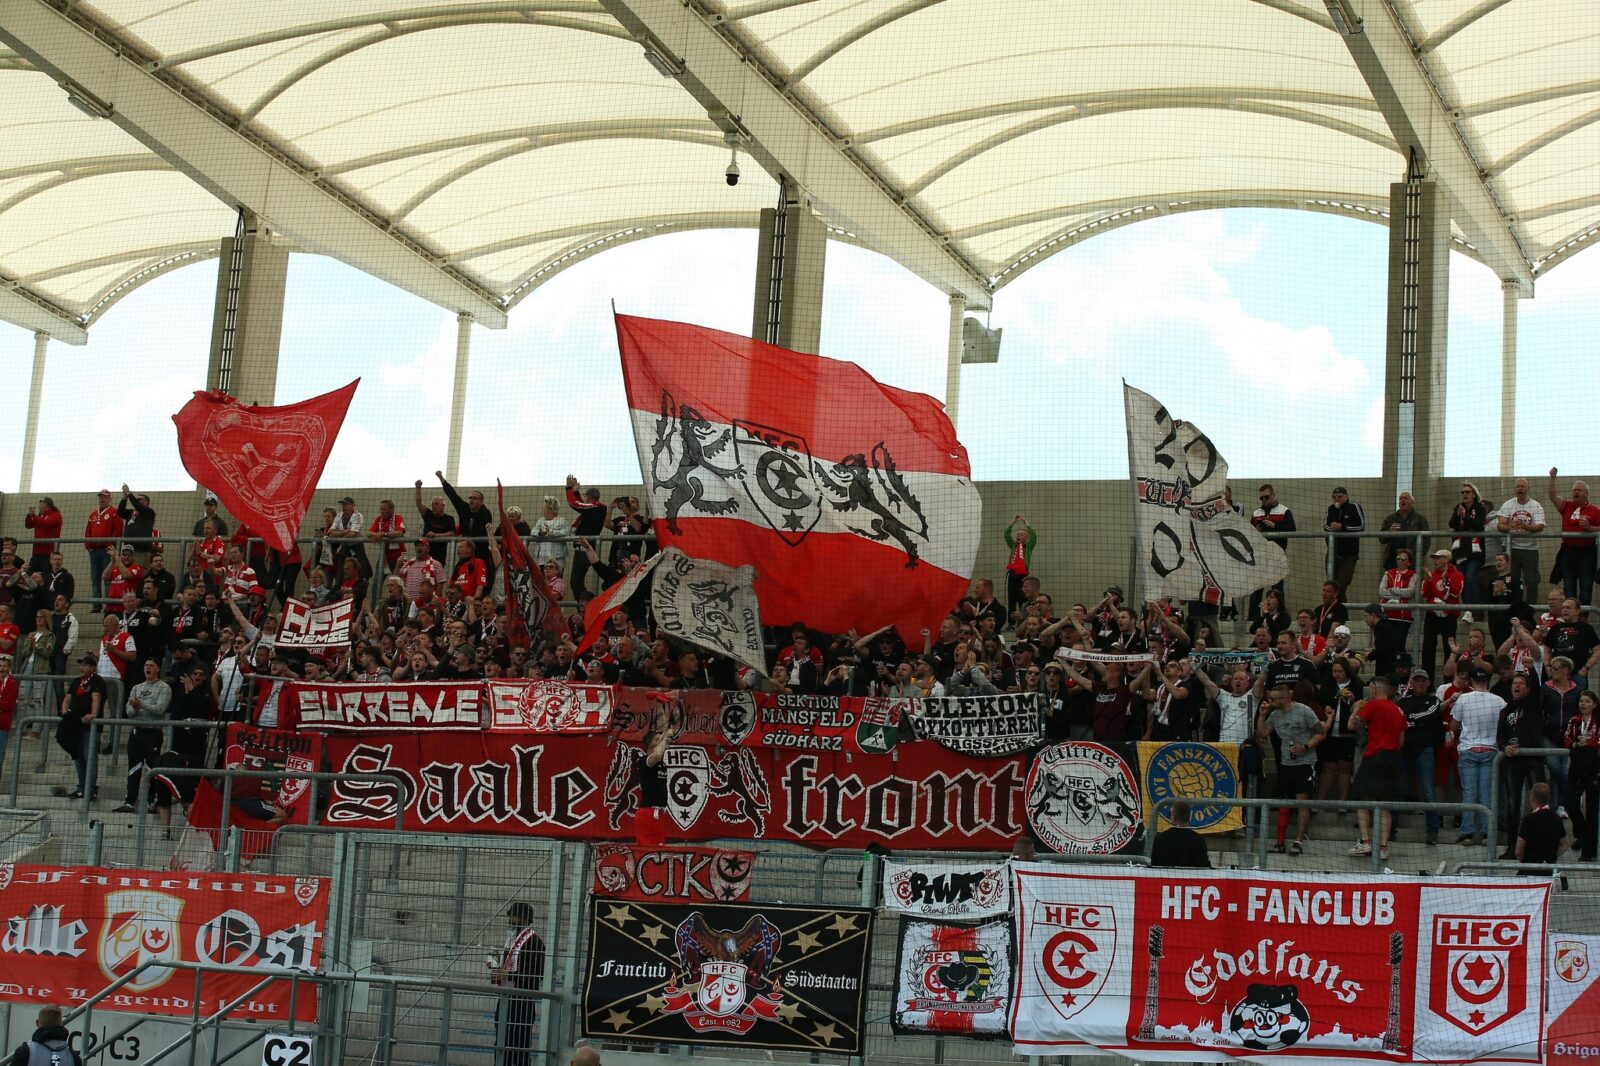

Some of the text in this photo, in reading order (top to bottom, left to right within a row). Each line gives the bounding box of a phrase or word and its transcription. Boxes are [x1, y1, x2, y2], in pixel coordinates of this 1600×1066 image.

[283, 600, 353, 636] HFC
[280, 627, 351, 646] CHEMIE
[545, 685, 566, 697] HFC
[777, 694, 840, 710] SEKTION
[299, 688, 481, 723] SURREALE
[924, 692, 1038, 718] ELEKOM
[761, 708, 855, 728] MANSFELD
[762, 729, 843, 751] SÜDHARZ
[287, 758, 310, 770] HFC
[667, 753, 701, 766] HFC
[1041, 743, 1121, 770] Ultras
[1157, 748, 1228, 782] FANSZENE
[327, 743, 1027, 839] Saale front
[1068, 778, 1091, 789] HFC
[14, 870, 287, 895] Fanclub
[636, 851, 715, 900] CTK
[121, 895, 166, 911] HFC
[1161, 885, 1221, 921] HFC
[1247, 886, 1395, 926] FANCLUB
[1045, 906, 1101, 928] HFC
[0, 904, 324, 975] alle Ost
[1440, 921, 1520, 946] HFC
[925, 951, 953, 962] HFC
[596, 959, 667, 978] Fanclub
[711, 964, 737, 975] HFC
[1184, 938, 1365, 1005] Edelfans
[0, 983, 53, 998] Die
[785, 970, 857, 990] Südstaaten
[110, 1035, 140, 1060] C3
[264, 1038, 312, 1066] C2
[1553, 1042, 1600, 1059] Briga
